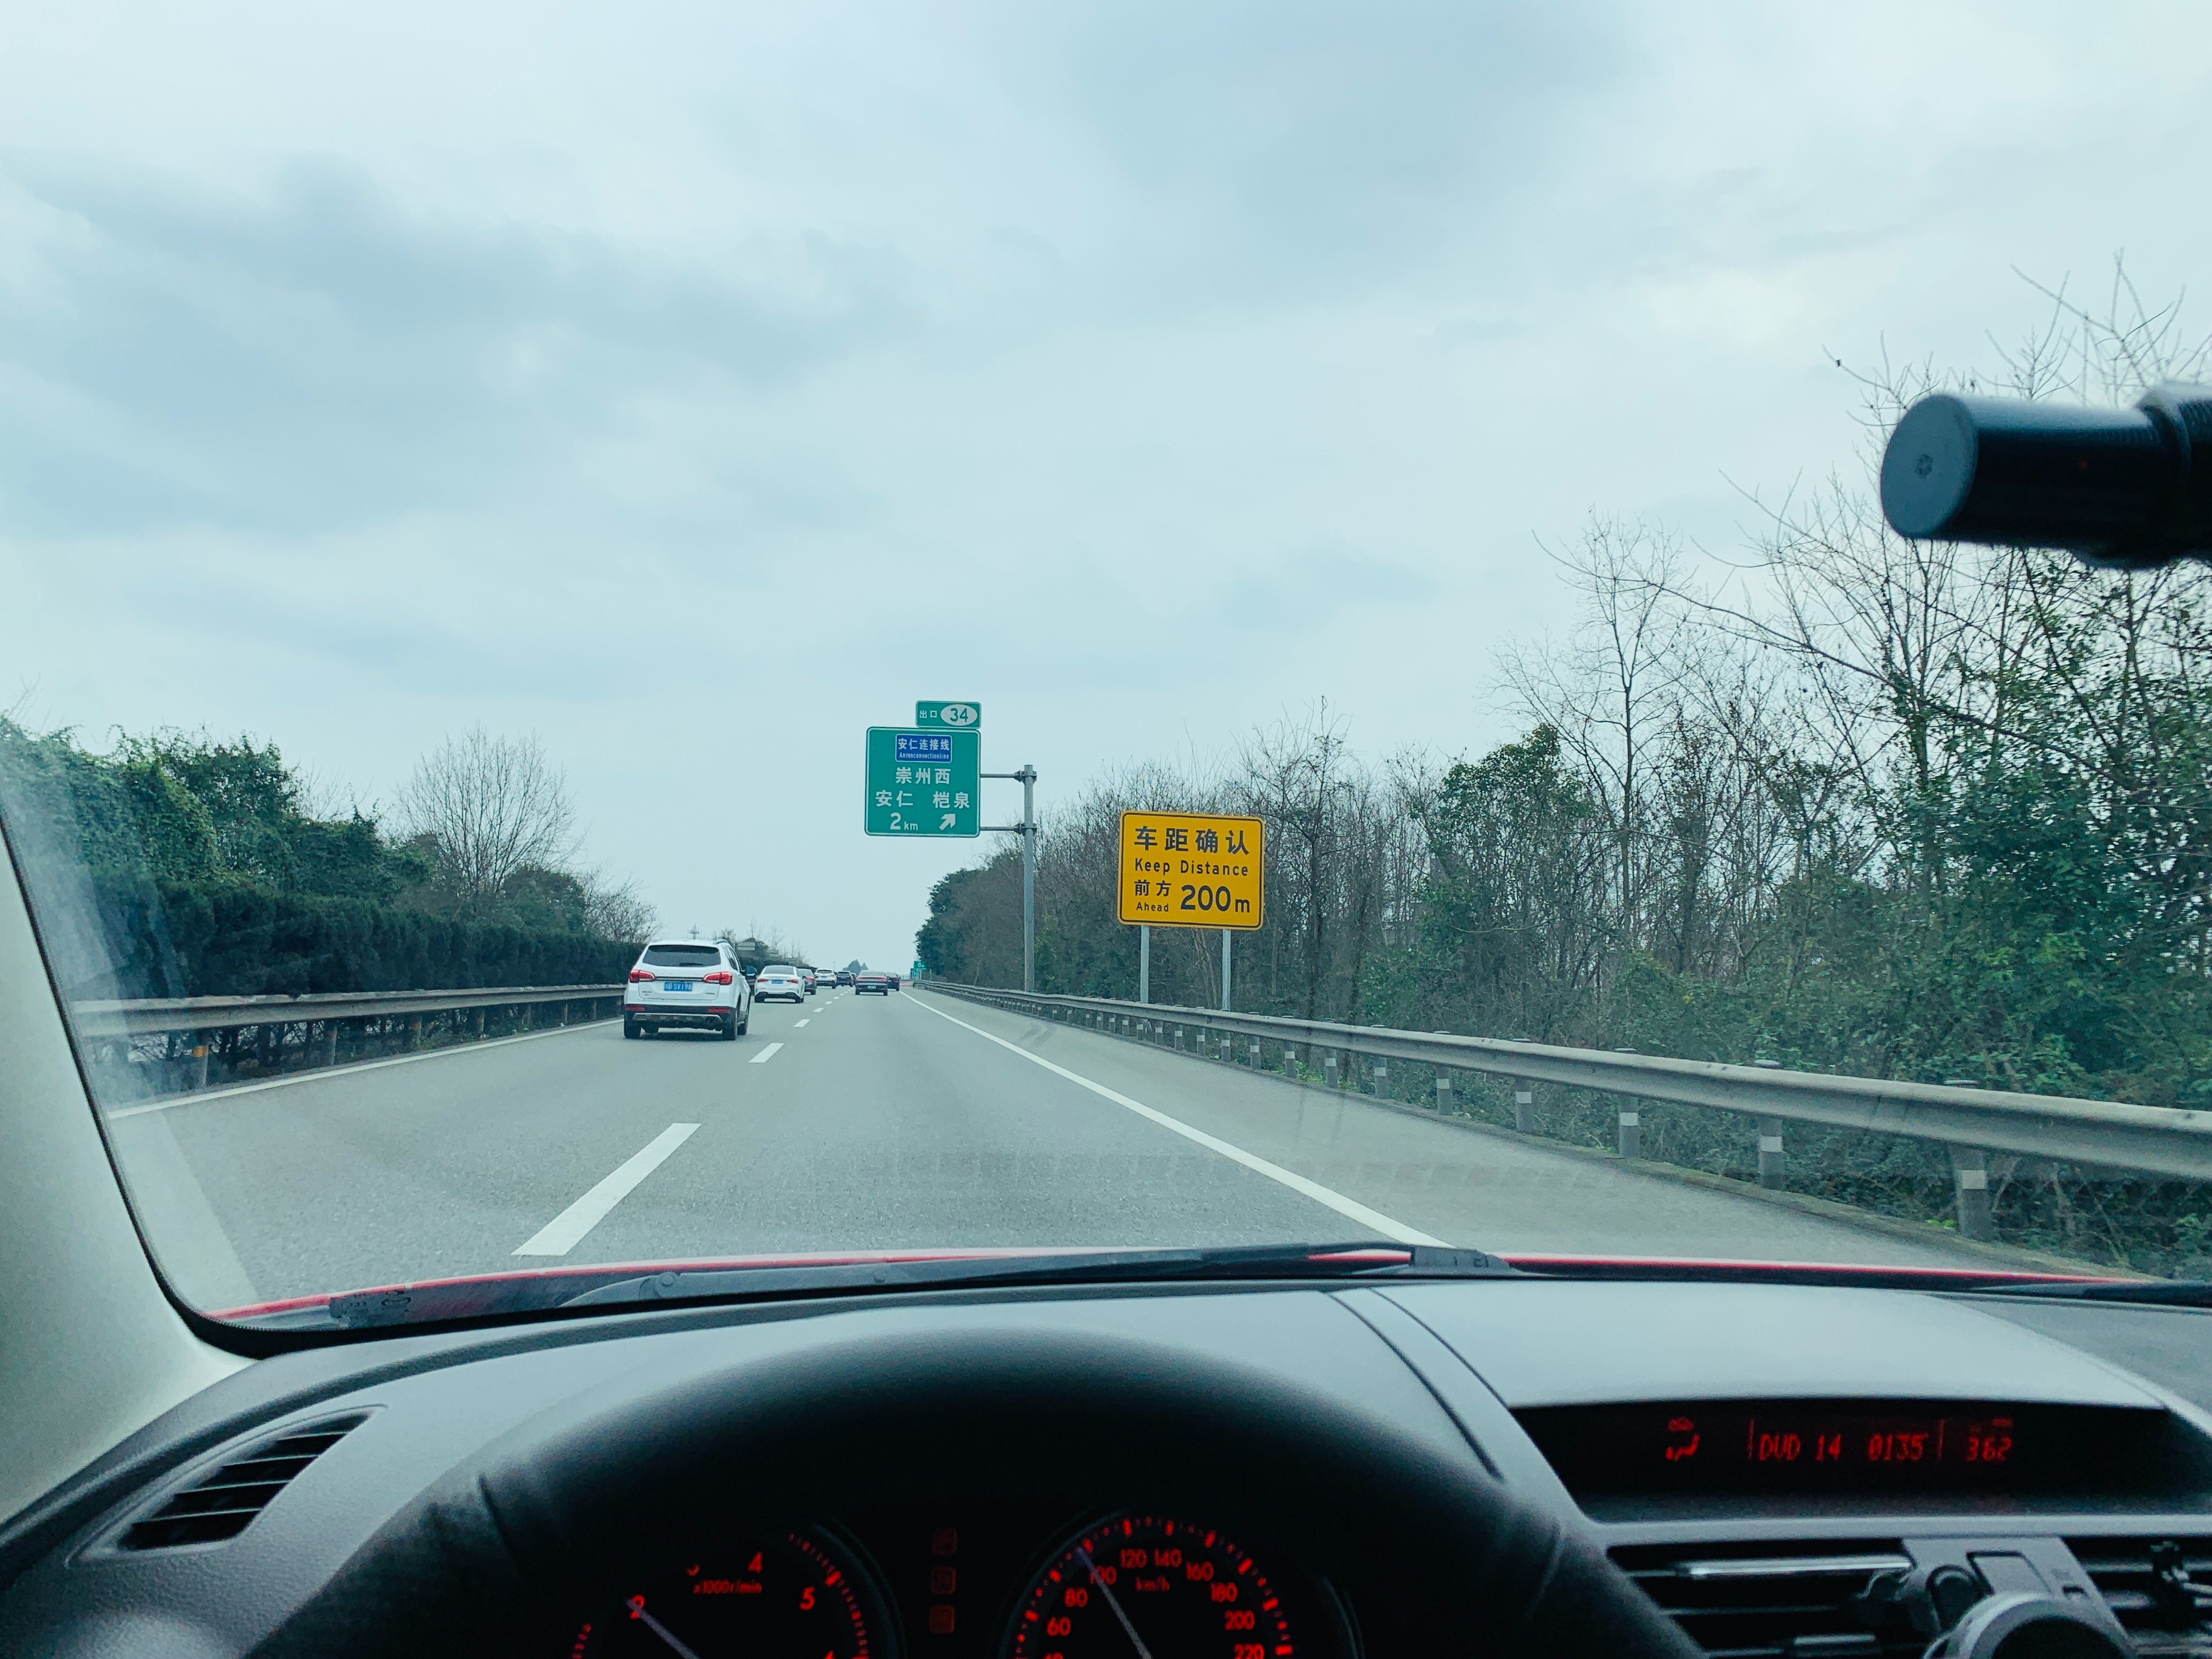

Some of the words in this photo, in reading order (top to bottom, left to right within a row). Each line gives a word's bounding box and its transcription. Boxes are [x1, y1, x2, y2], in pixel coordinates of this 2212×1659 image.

[919, 709, 938, 719] 出口
[950, 707, 969, 723] 34
[898, 738, 950, 751] 安仁连接线
[895, 767, 951, 785] 崇州西
[875, 790, 913, 808] 安仁
[933, 791, 970, 809] 桤泉
[1134, 826, 1250, 855] 车距确认
[1135, 857, 1170, 876] Keep
[1180, 860, 1249, 876] Distance
[1134, 879, 1172, 897] 前方
[1136, 901, 1169, 912] Ahead
[748, 1551, 763, 1573] 4
[1120, 1548, 1148, 1568] 120
[1154, 1548, 1182, 1568] 140
[1186, 1561, 1214, 1582] 160
[1136, 1576, 1170, 1591] km/h
[1211, 1582, 1238, 1602] 180
[800, 1587, 815, 1610] 5
[1064, 1587, 1088, 1608] 80
[1047, 1616, 1071, 1637] 60
[1225, 1610, 1255, 1631] 200
